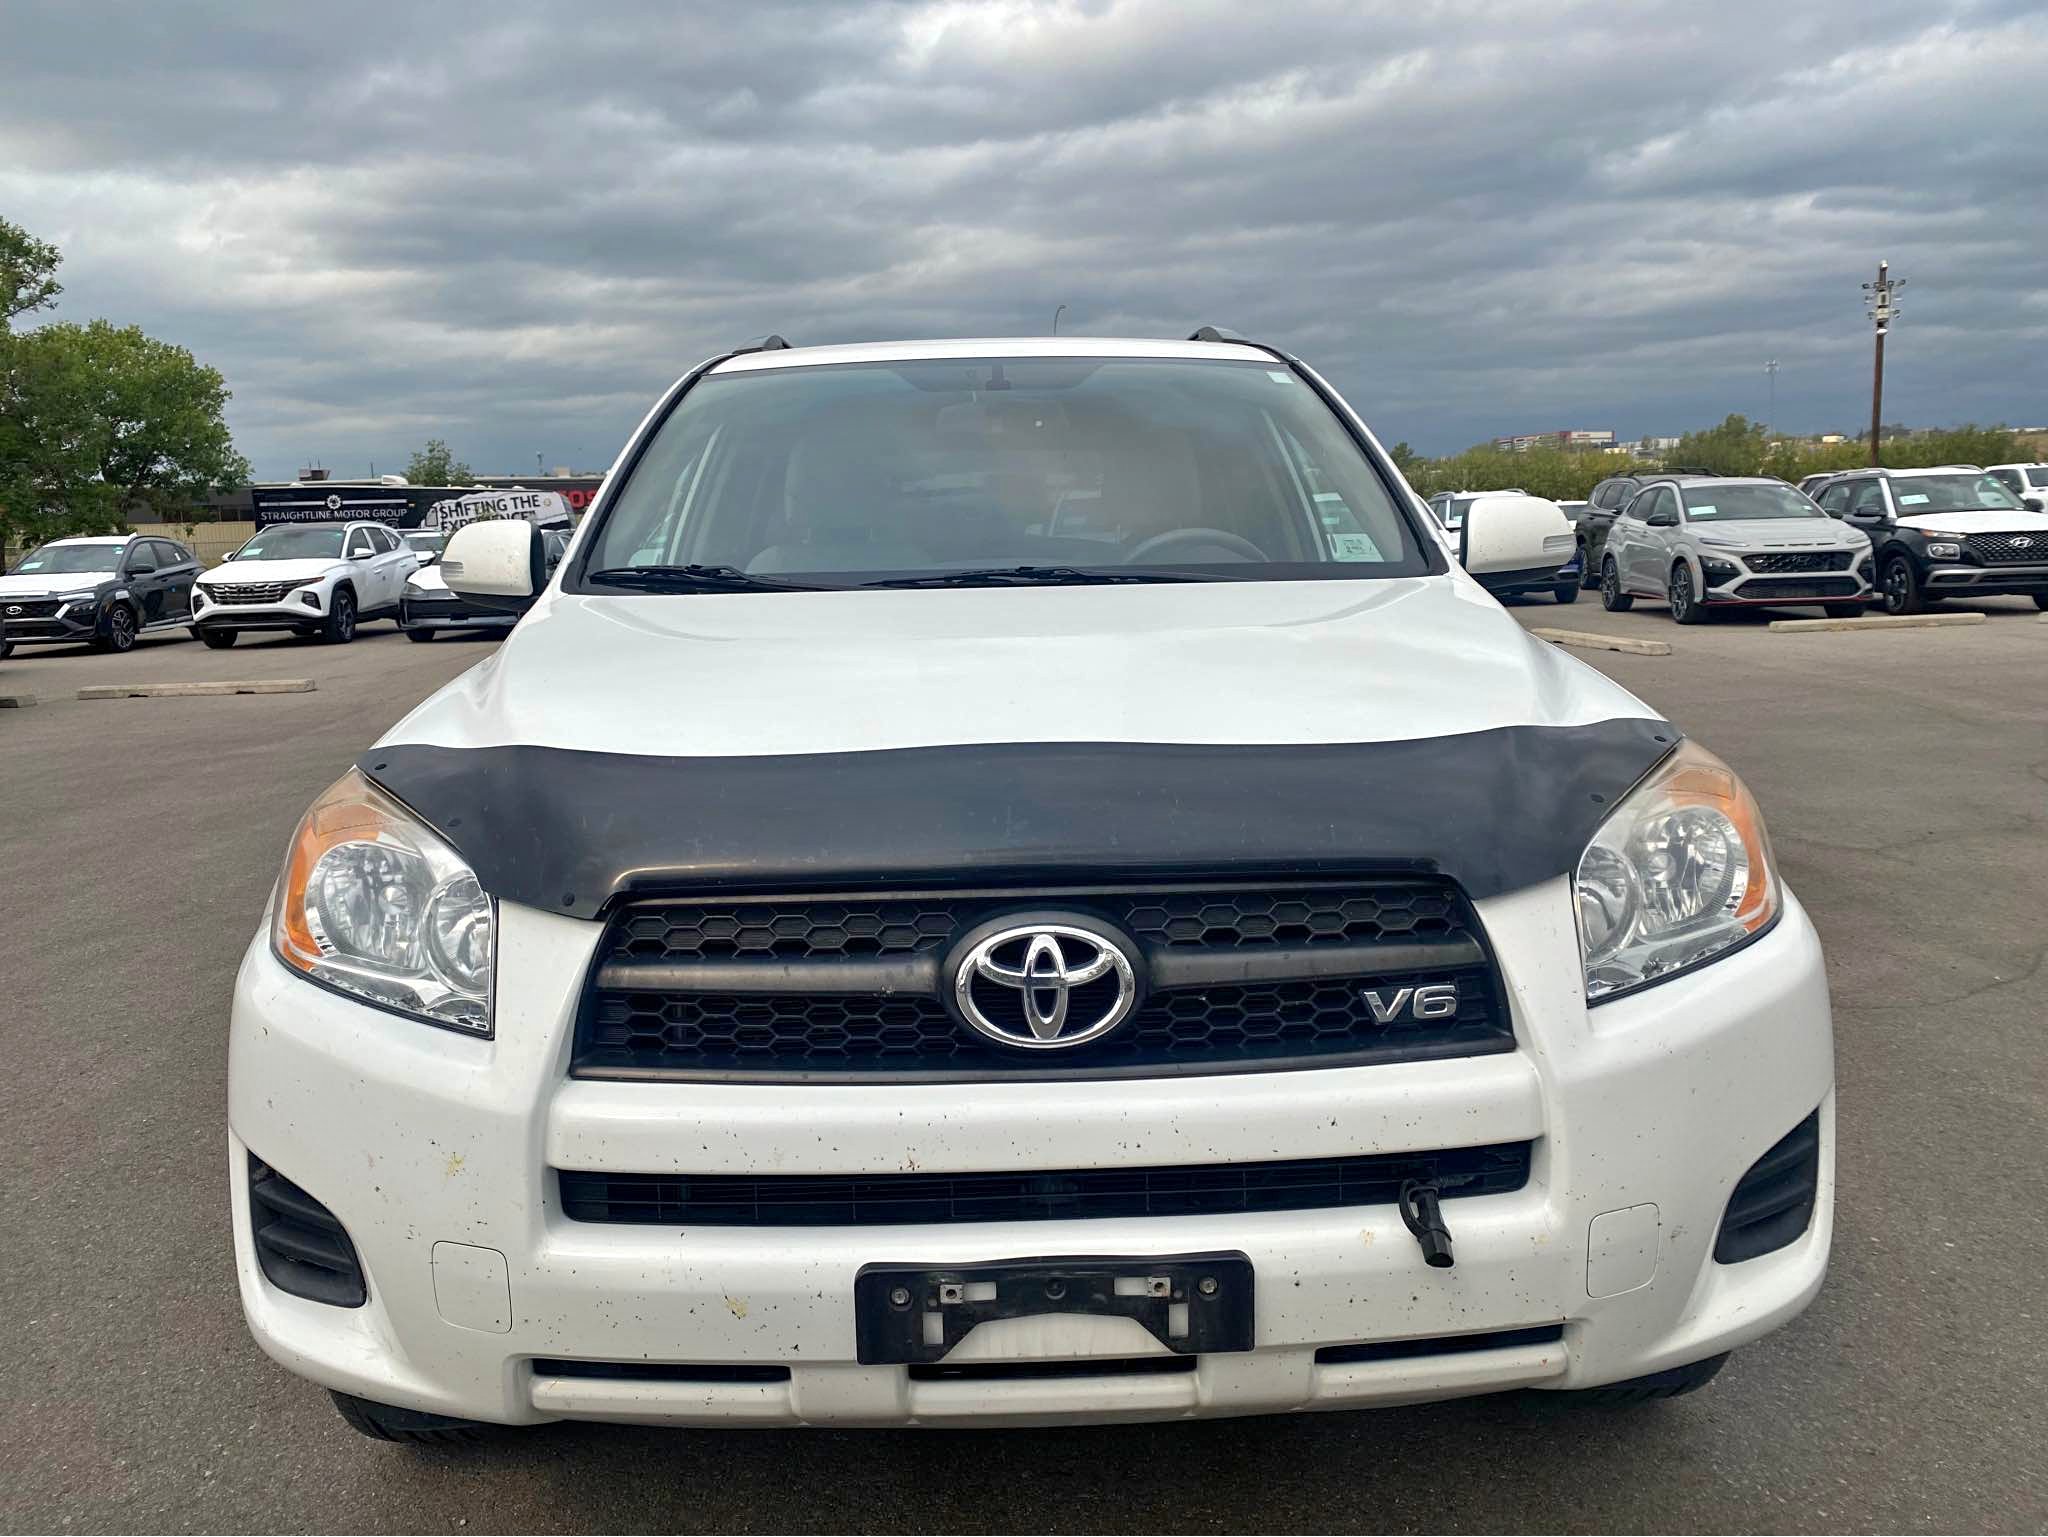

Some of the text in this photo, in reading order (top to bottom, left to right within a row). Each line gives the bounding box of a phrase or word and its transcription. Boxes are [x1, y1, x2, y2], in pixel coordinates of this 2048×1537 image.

[260, 508, 408, 520] STRAIGHTLINE MOTOR GROUP
[439, 498, 508, 519] SHIFTING
[510, 494, 541, 510] THE
[1364, 985, 1457, 1023] V6
